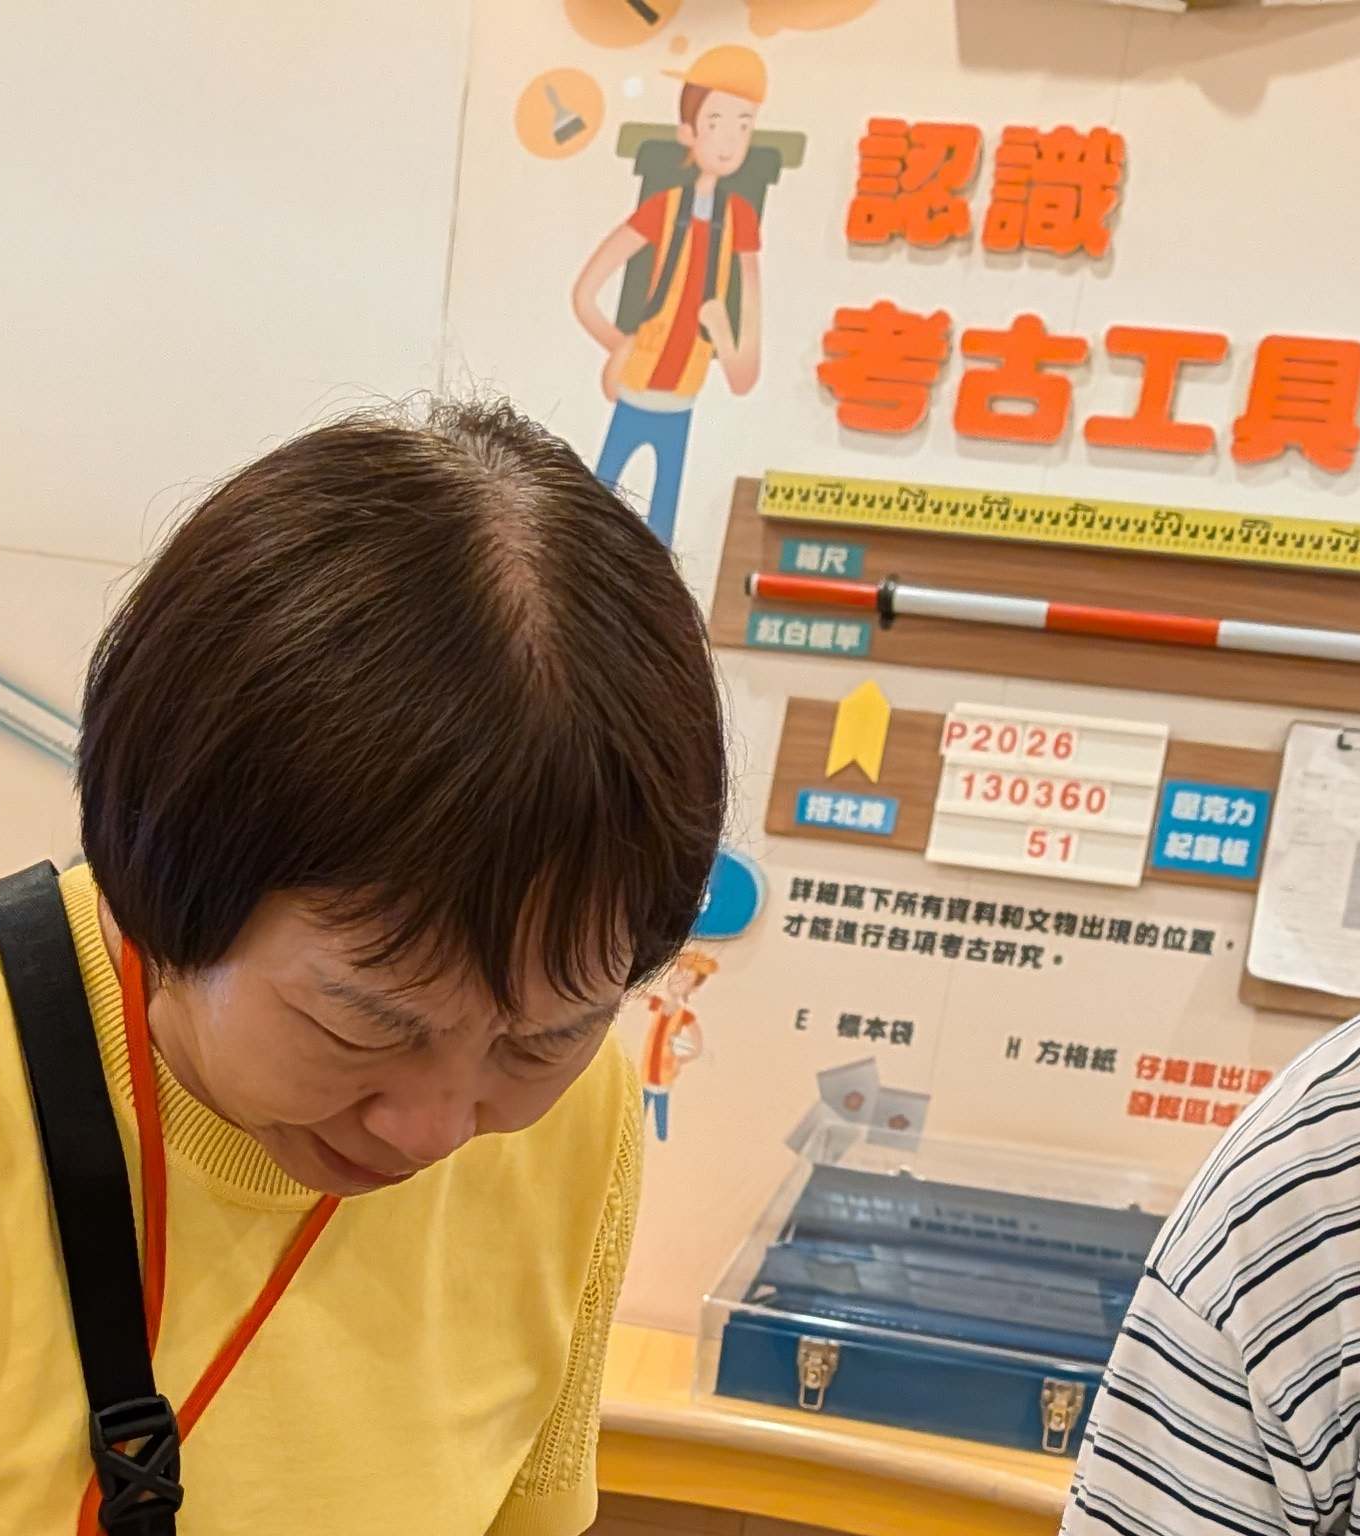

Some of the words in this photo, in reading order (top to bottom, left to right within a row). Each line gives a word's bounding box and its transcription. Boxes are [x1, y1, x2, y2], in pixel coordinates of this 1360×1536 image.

[846, 117, 1126, 259] 認識
[944, 721, 1074, 760] P2026
[961, 773, 1107, 815] 130360
[1027, 829, 1074, 862] 51
[782, 913, 1063, 970] 才能進行各項考古研究。
[795, 1008, 808, 1031] E
[1005, 1036, 1021, 1059] H
